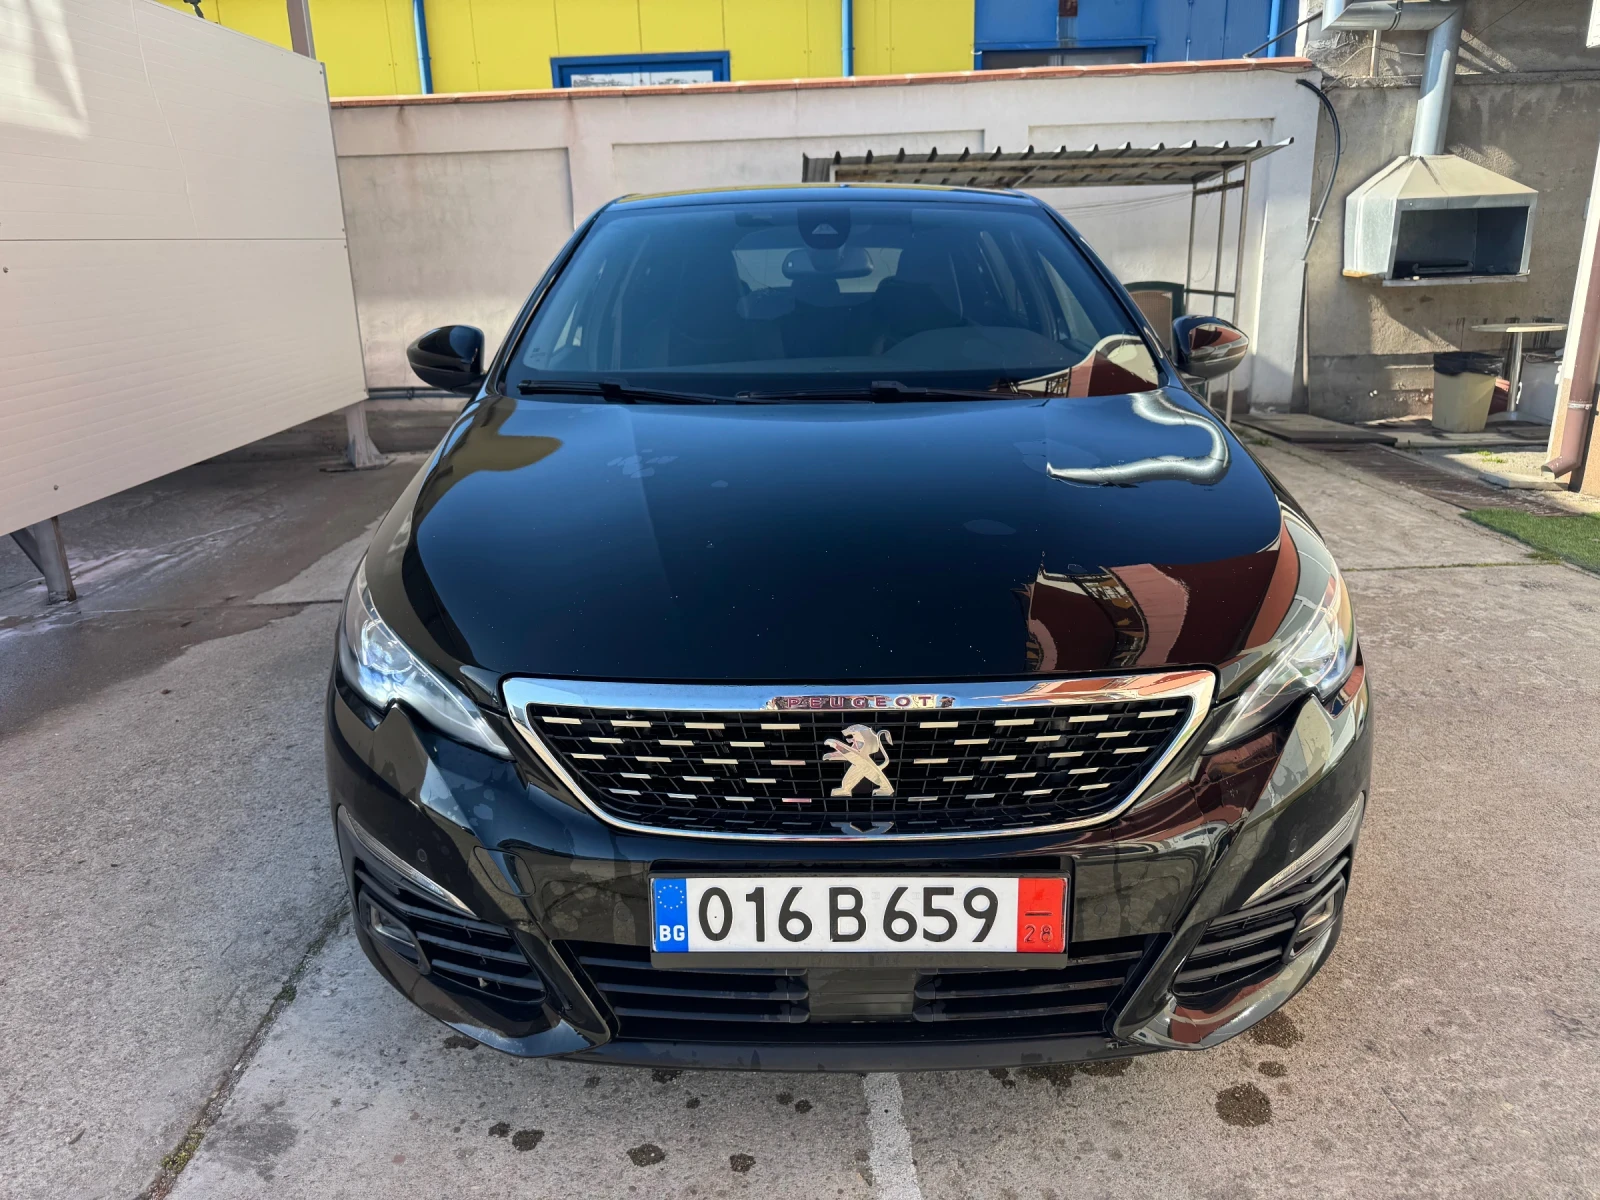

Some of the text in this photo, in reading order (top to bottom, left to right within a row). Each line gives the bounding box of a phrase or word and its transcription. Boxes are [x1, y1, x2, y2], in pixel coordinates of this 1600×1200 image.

[786, 695, 932, 708] PEUGEOT
[659, 925, 686, 942] BG
[1023, 924, 1053, 943] 28
